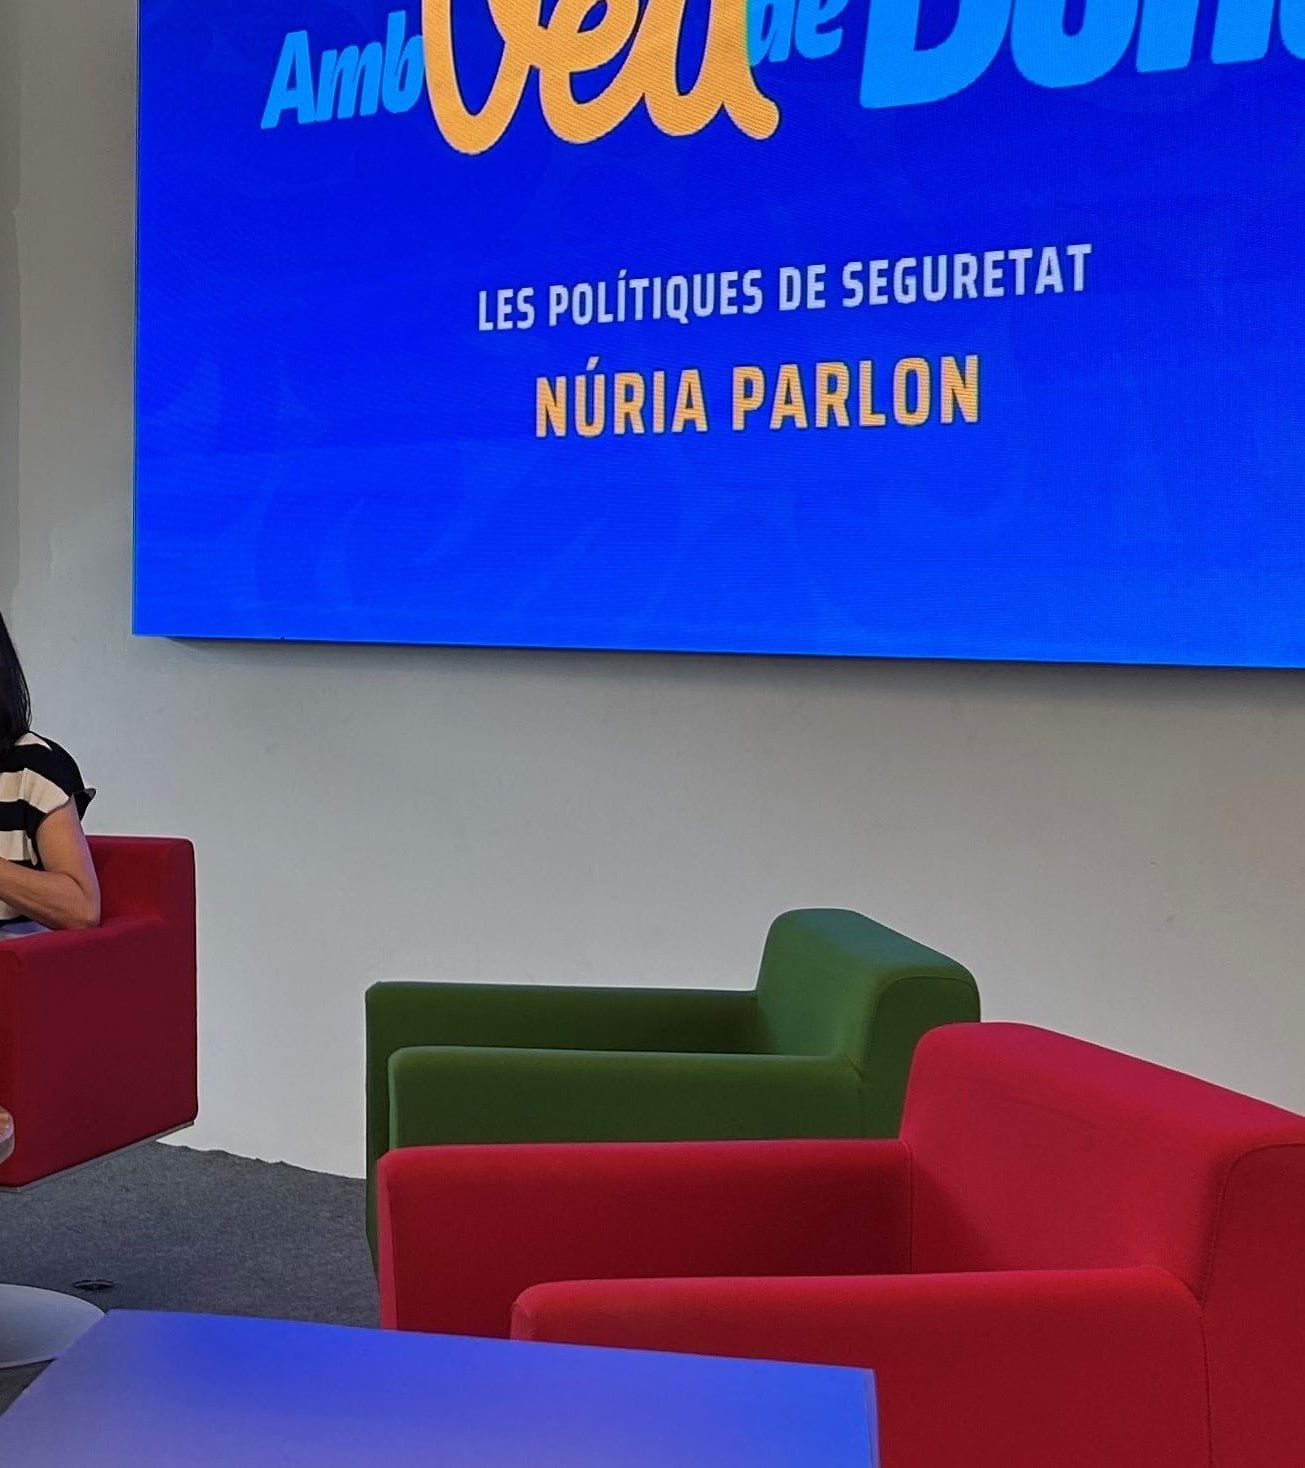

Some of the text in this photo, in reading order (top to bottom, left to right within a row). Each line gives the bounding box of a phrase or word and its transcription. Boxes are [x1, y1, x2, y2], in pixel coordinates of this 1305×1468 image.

[260, 11, 425, 129] Amb
[478, 244, 1092, 331] LES POLÍTIQUES DE SEGURETAT
[535, 355, 979, 438] NÚRIA PARLON
